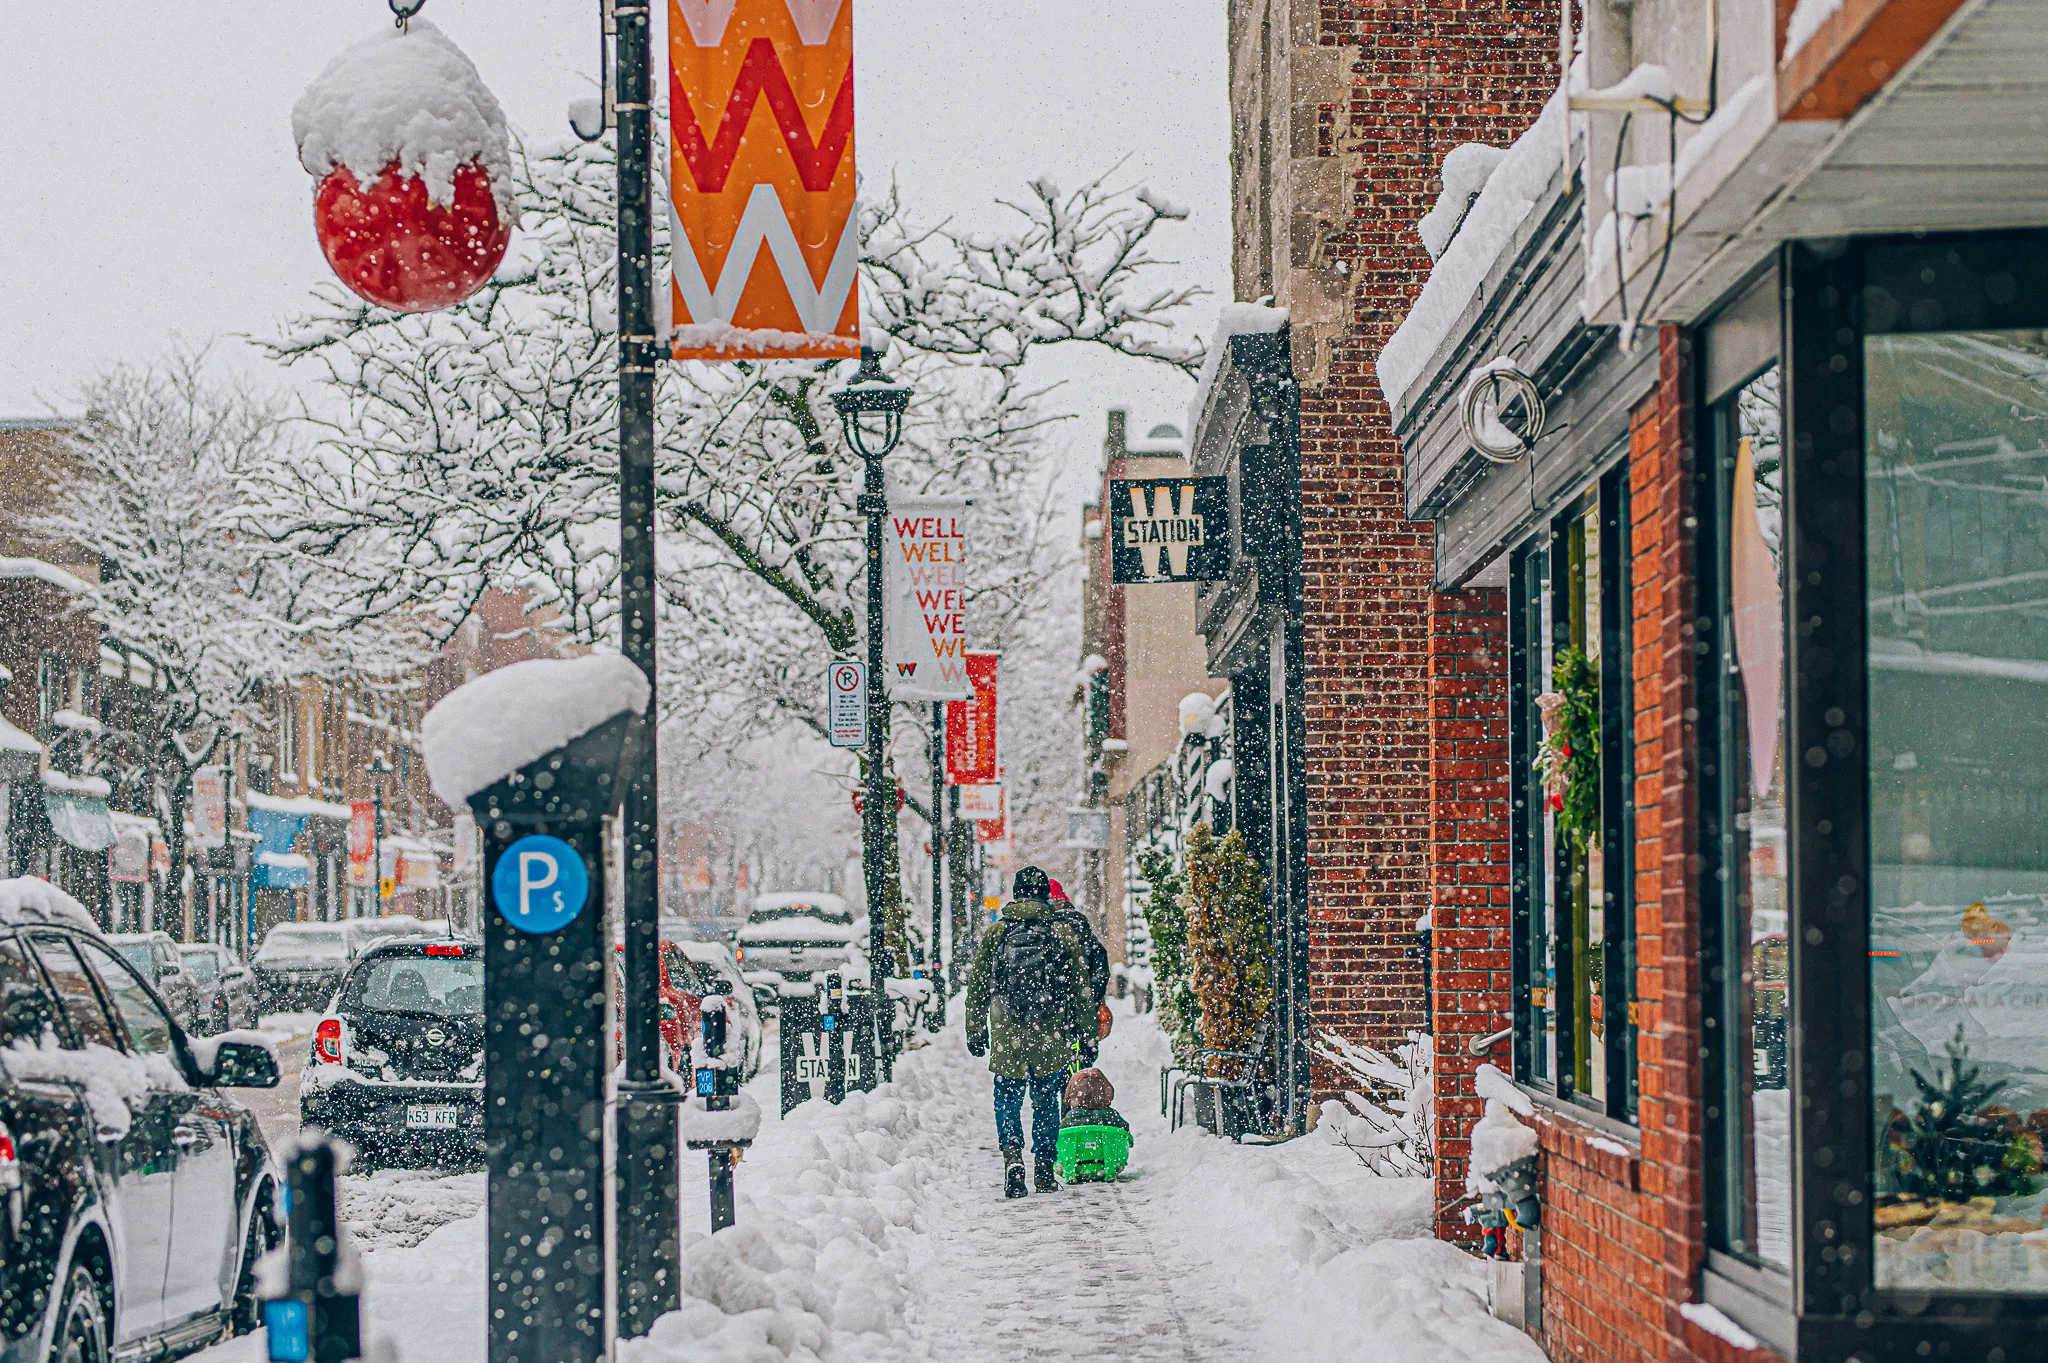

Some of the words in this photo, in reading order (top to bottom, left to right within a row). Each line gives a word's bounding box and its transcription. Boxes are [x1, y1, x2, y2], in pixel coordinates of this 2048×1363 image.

[893, 517, 964, 539] WELL
[1127, 518, 1200, 544] STATION
[923, 613, 966, 634] WE
[700, 1071, 711, 1082] VP
[800, 1058, 857, 1078] STAN
[698, 1083, 713, 1094] 206
[435, 1110, 456, 1124] KFR
